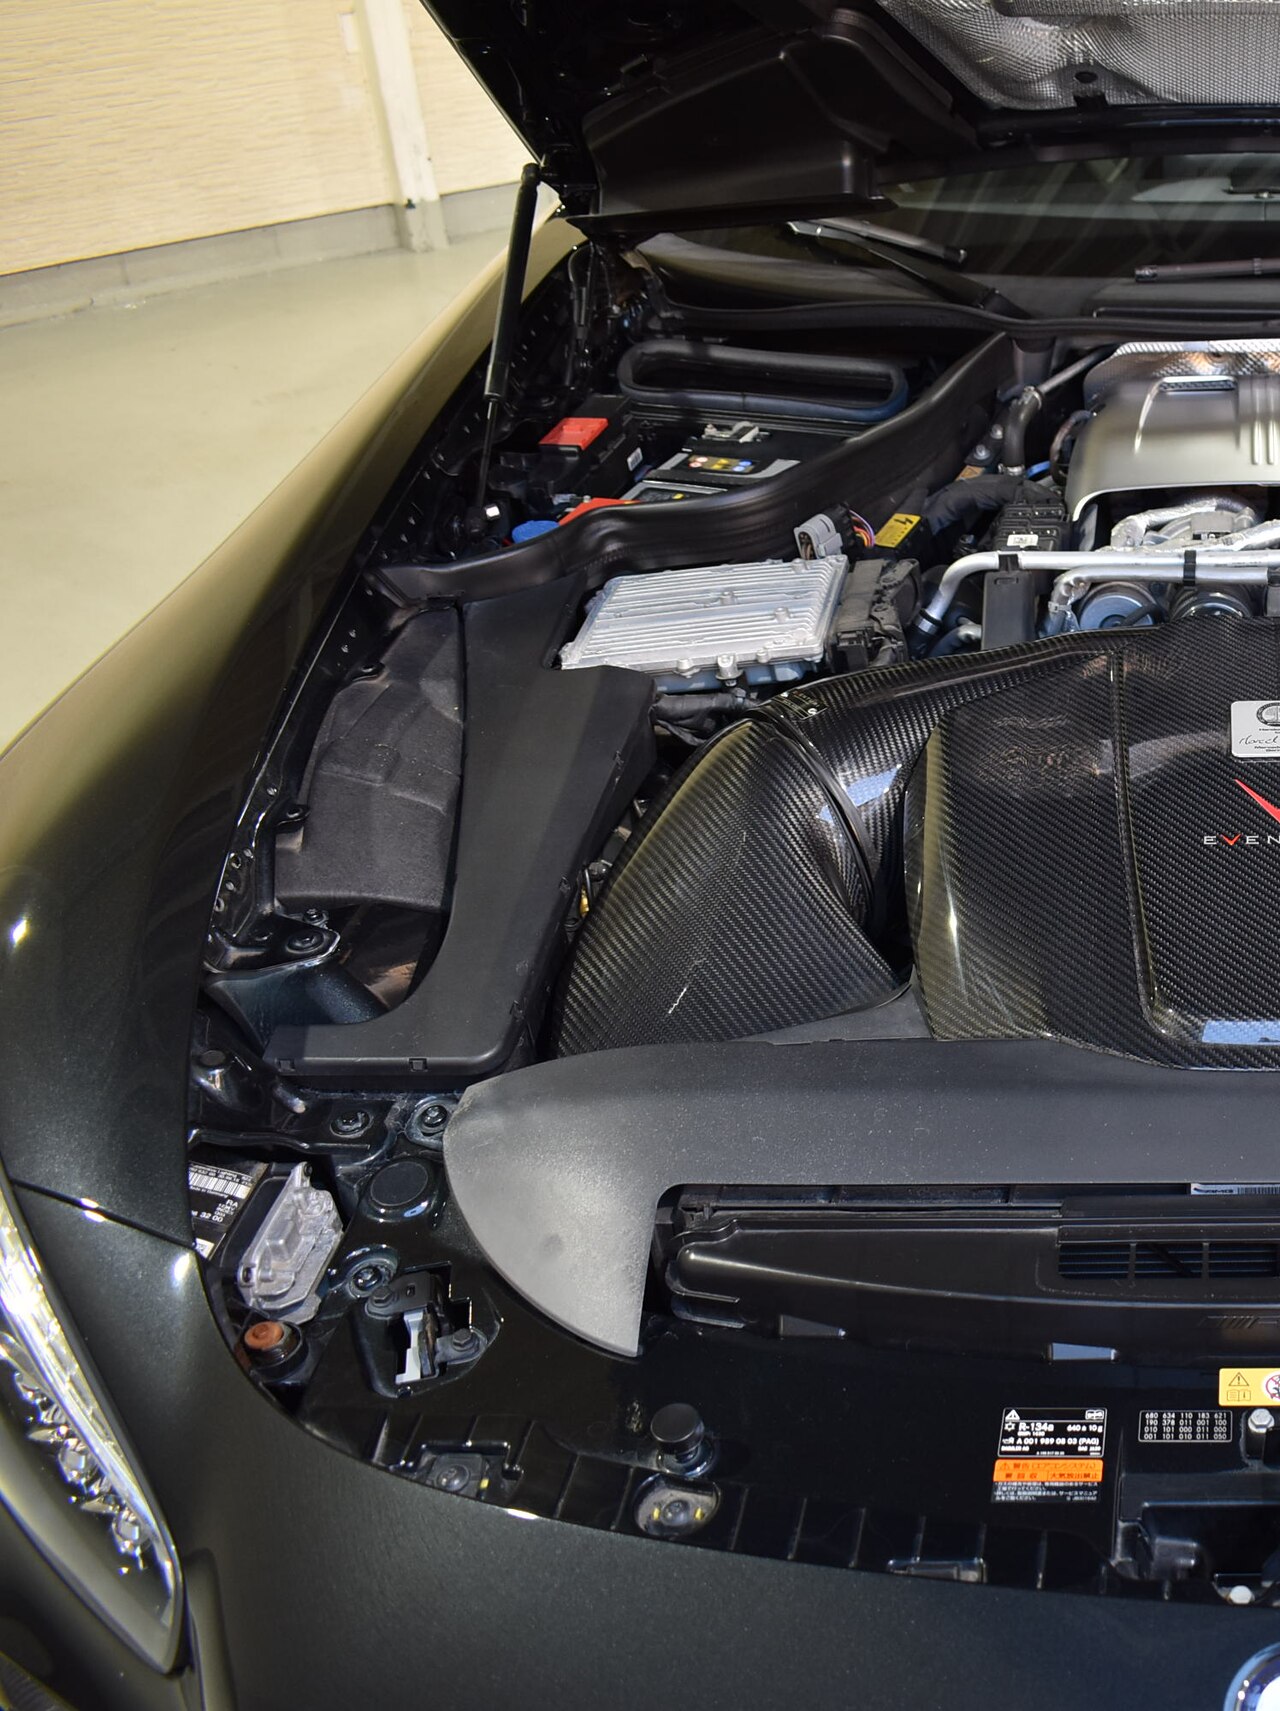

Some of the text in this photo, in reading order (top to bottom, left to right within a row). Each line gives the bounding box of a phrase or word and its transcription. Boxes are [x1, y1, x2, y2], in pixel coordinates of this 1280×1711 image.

[1018, 1422, 1054, 1432] R-134a
[1023, 1437, 1038, 1445] 001
[1040, 1437, 1054, 1445] 989
[1067, 1437, 1077, 1445] 03
